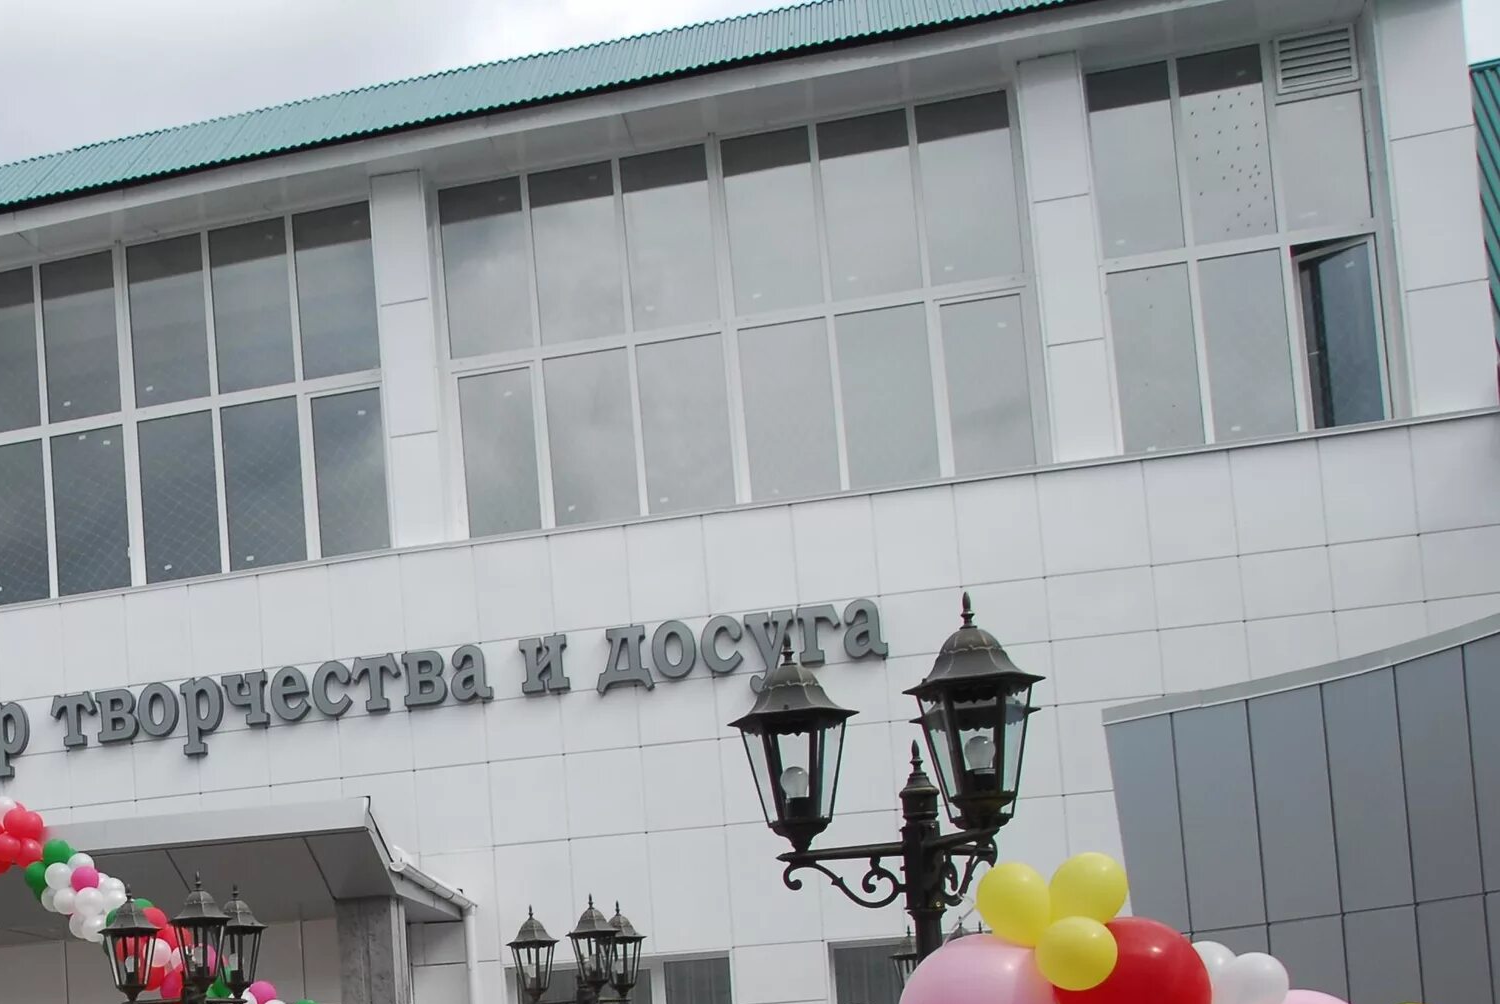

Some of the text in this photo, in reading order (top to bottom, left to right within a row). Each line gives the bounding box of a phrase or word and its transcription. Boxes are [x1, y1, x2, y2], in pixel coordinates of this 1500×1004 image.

[51, 643, 493, 756] творчества
[518, 634, 571, 695] и
[598, 598, 889, 695] досуга
